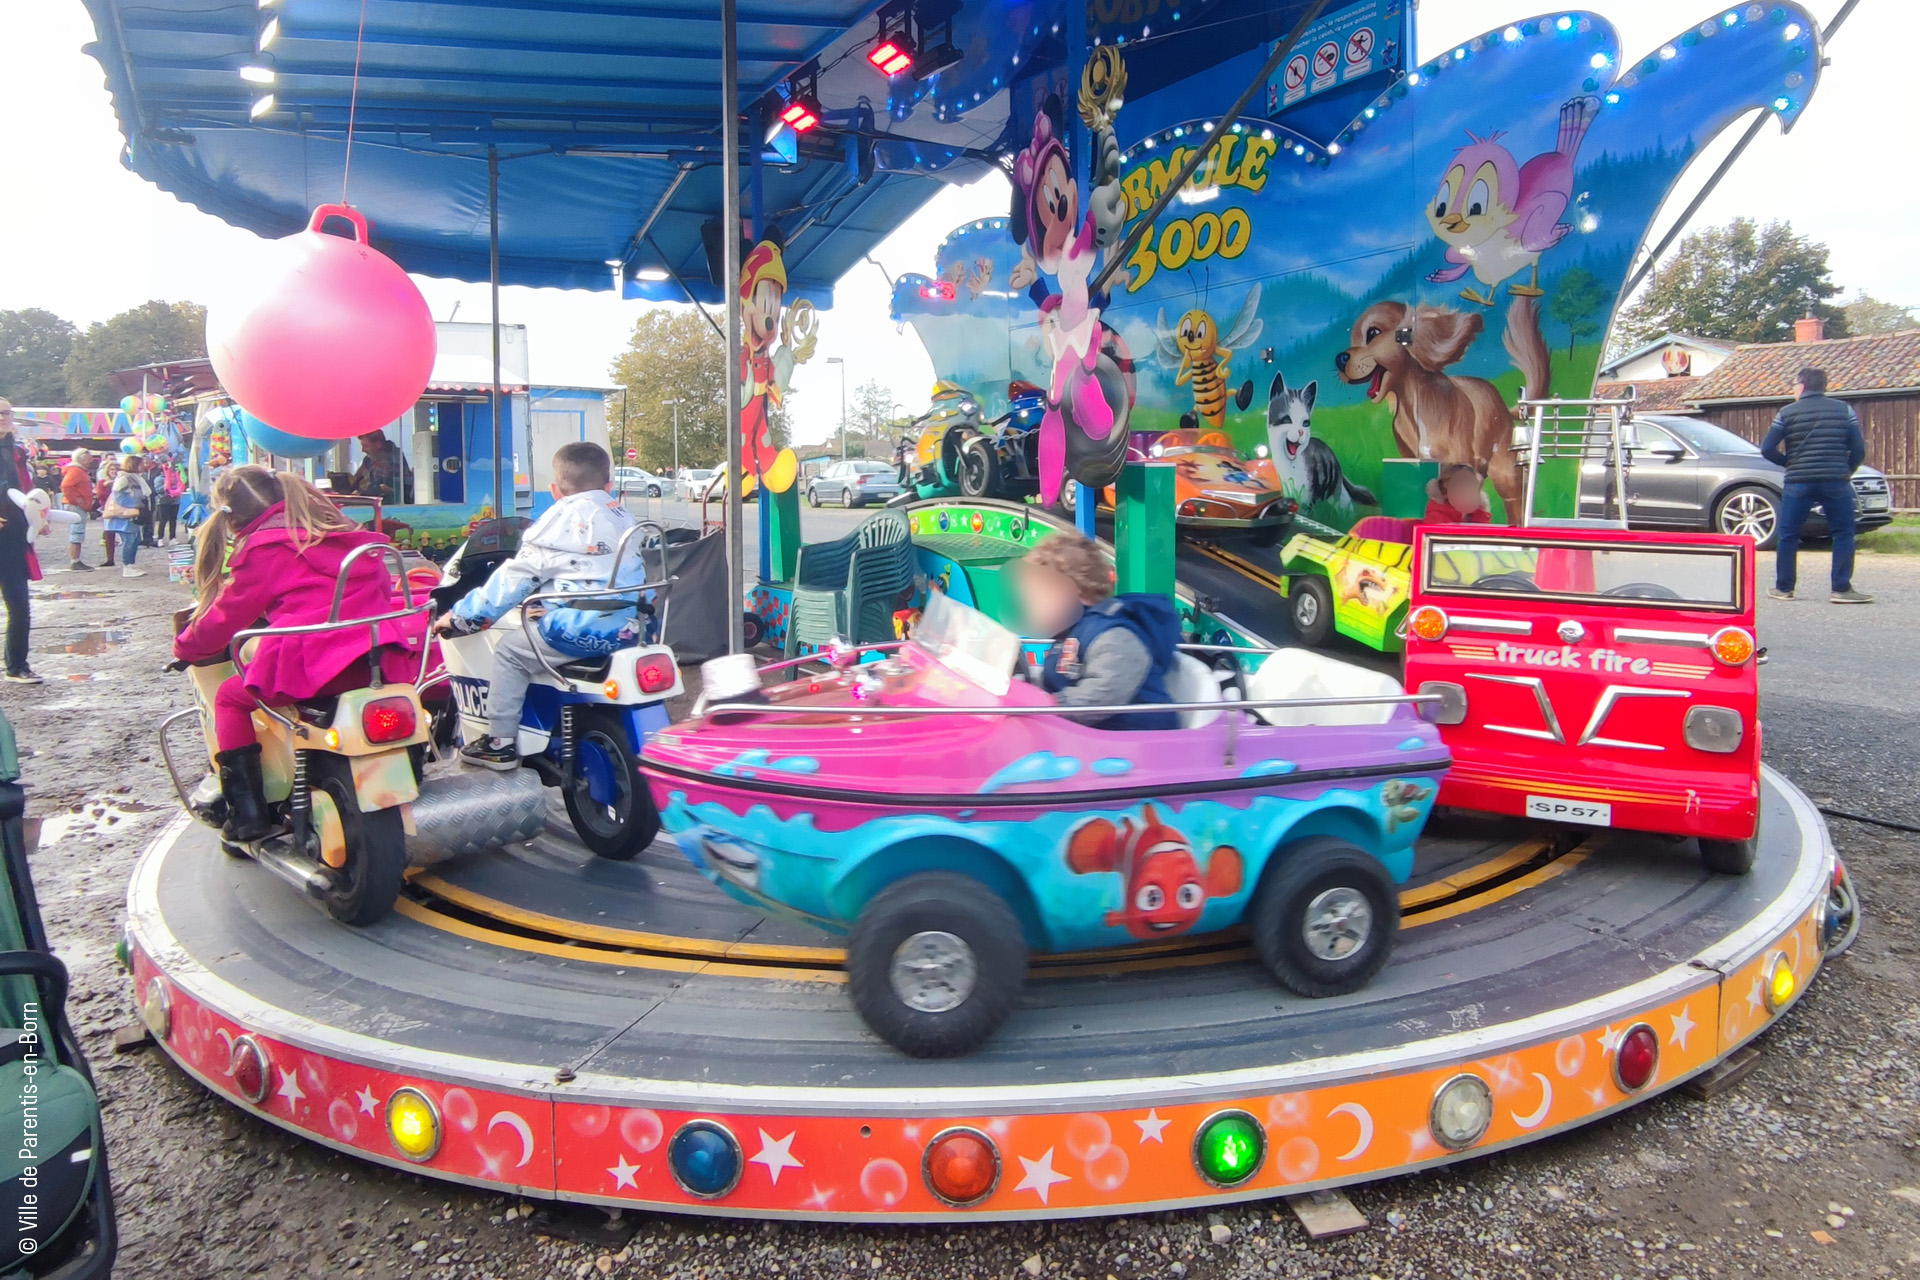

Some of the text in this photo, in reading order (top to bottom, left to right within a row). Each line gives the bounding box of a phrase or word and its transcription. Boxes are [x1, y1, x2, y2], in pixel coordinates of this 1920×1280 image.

[1120, 134, 1277, 220] RMULE
[1126, 207, 1251, 293] 3000
[1496, 641, 1652, 675] truck fire
